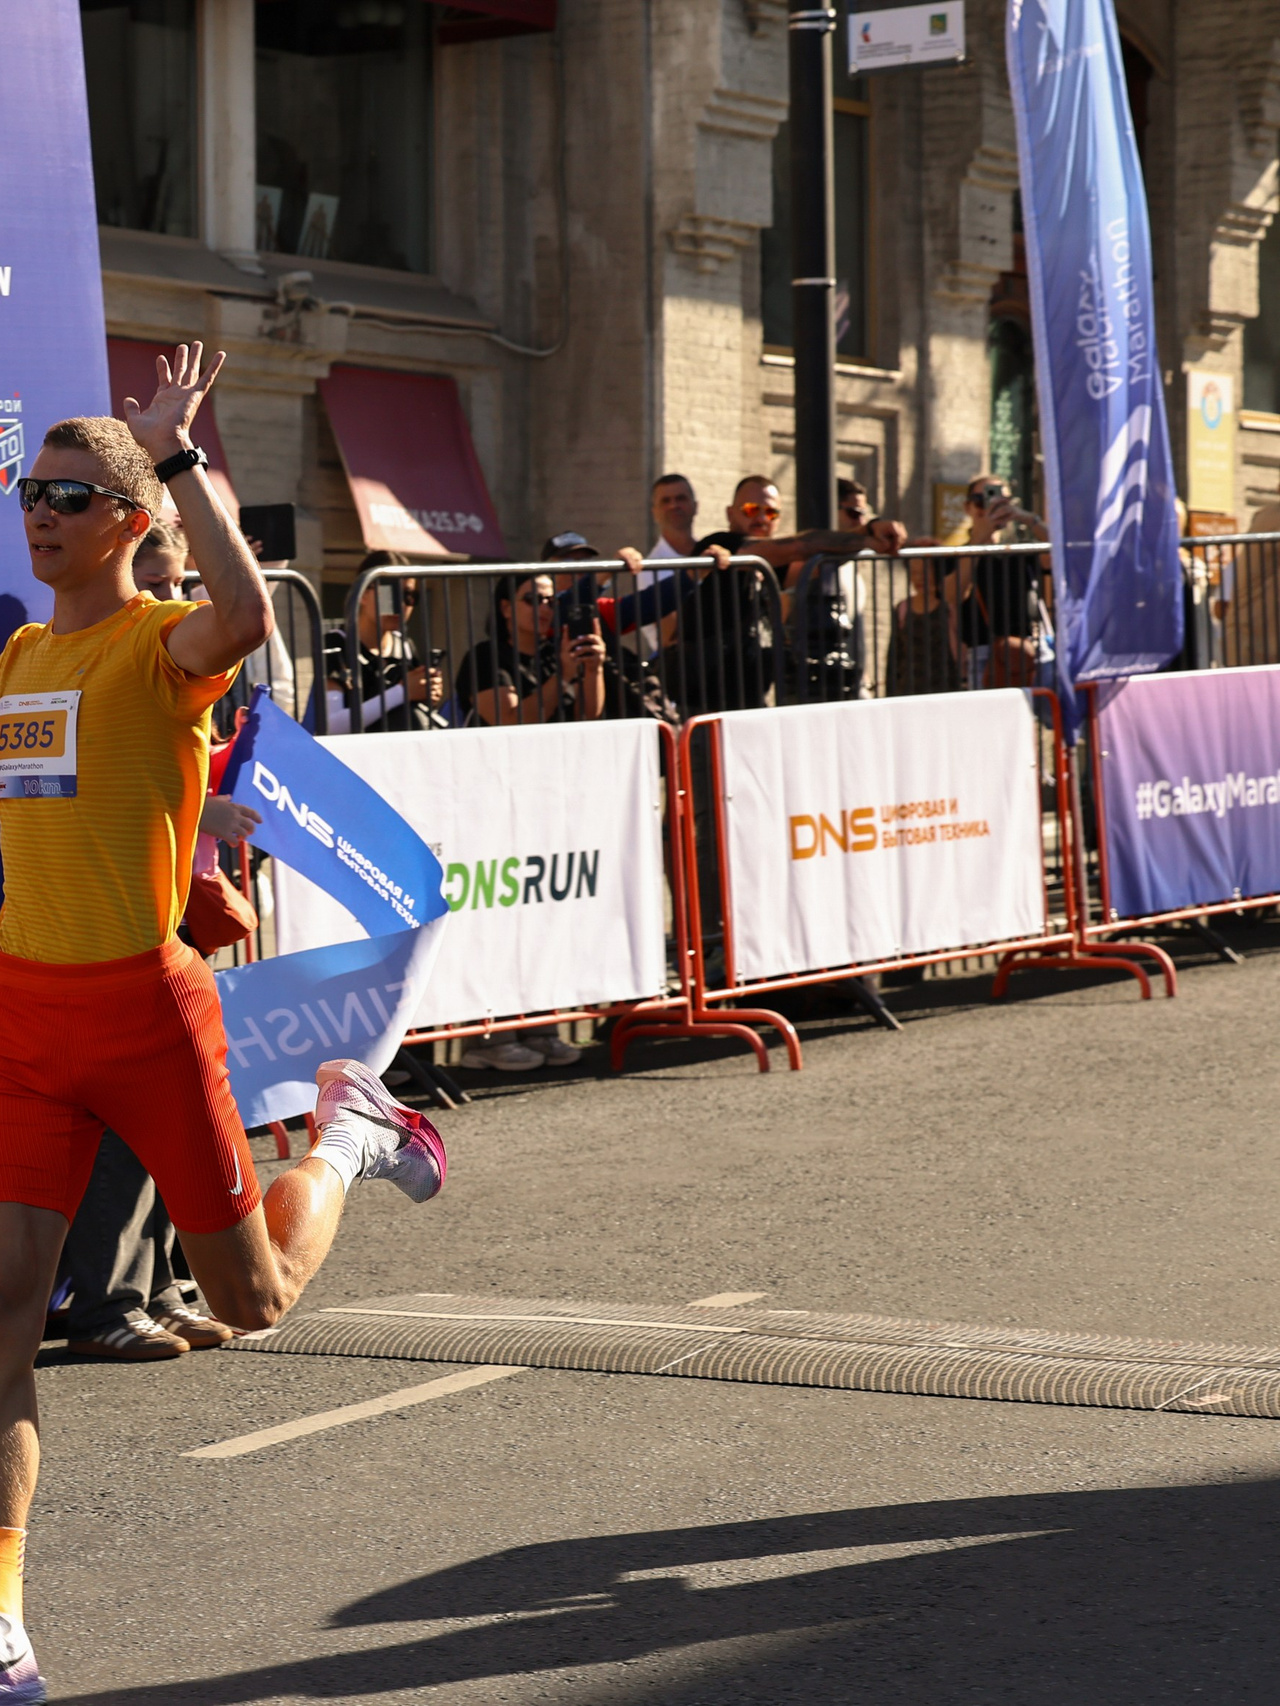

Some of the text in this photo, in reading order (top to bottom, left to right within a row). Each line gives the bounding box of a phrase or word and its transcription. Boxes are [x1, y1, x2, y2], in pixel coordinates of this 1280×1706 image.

[252, 761, 334, 850] DNS
[881, 797, 958, 824] ЦИФРОВАЯ И
[1136, 769, 1280, 820] #GalaxyMara
[790, 806, 877, 862] DNS
[882, 819, 991, 850] БЫТОВАЯ ТЕХНИКА
[336, 836, 403, 899] ЦИФРОВАЯ
[403, 894, 415, 910] И
[445, 849, 600, 913] DNSRUN
